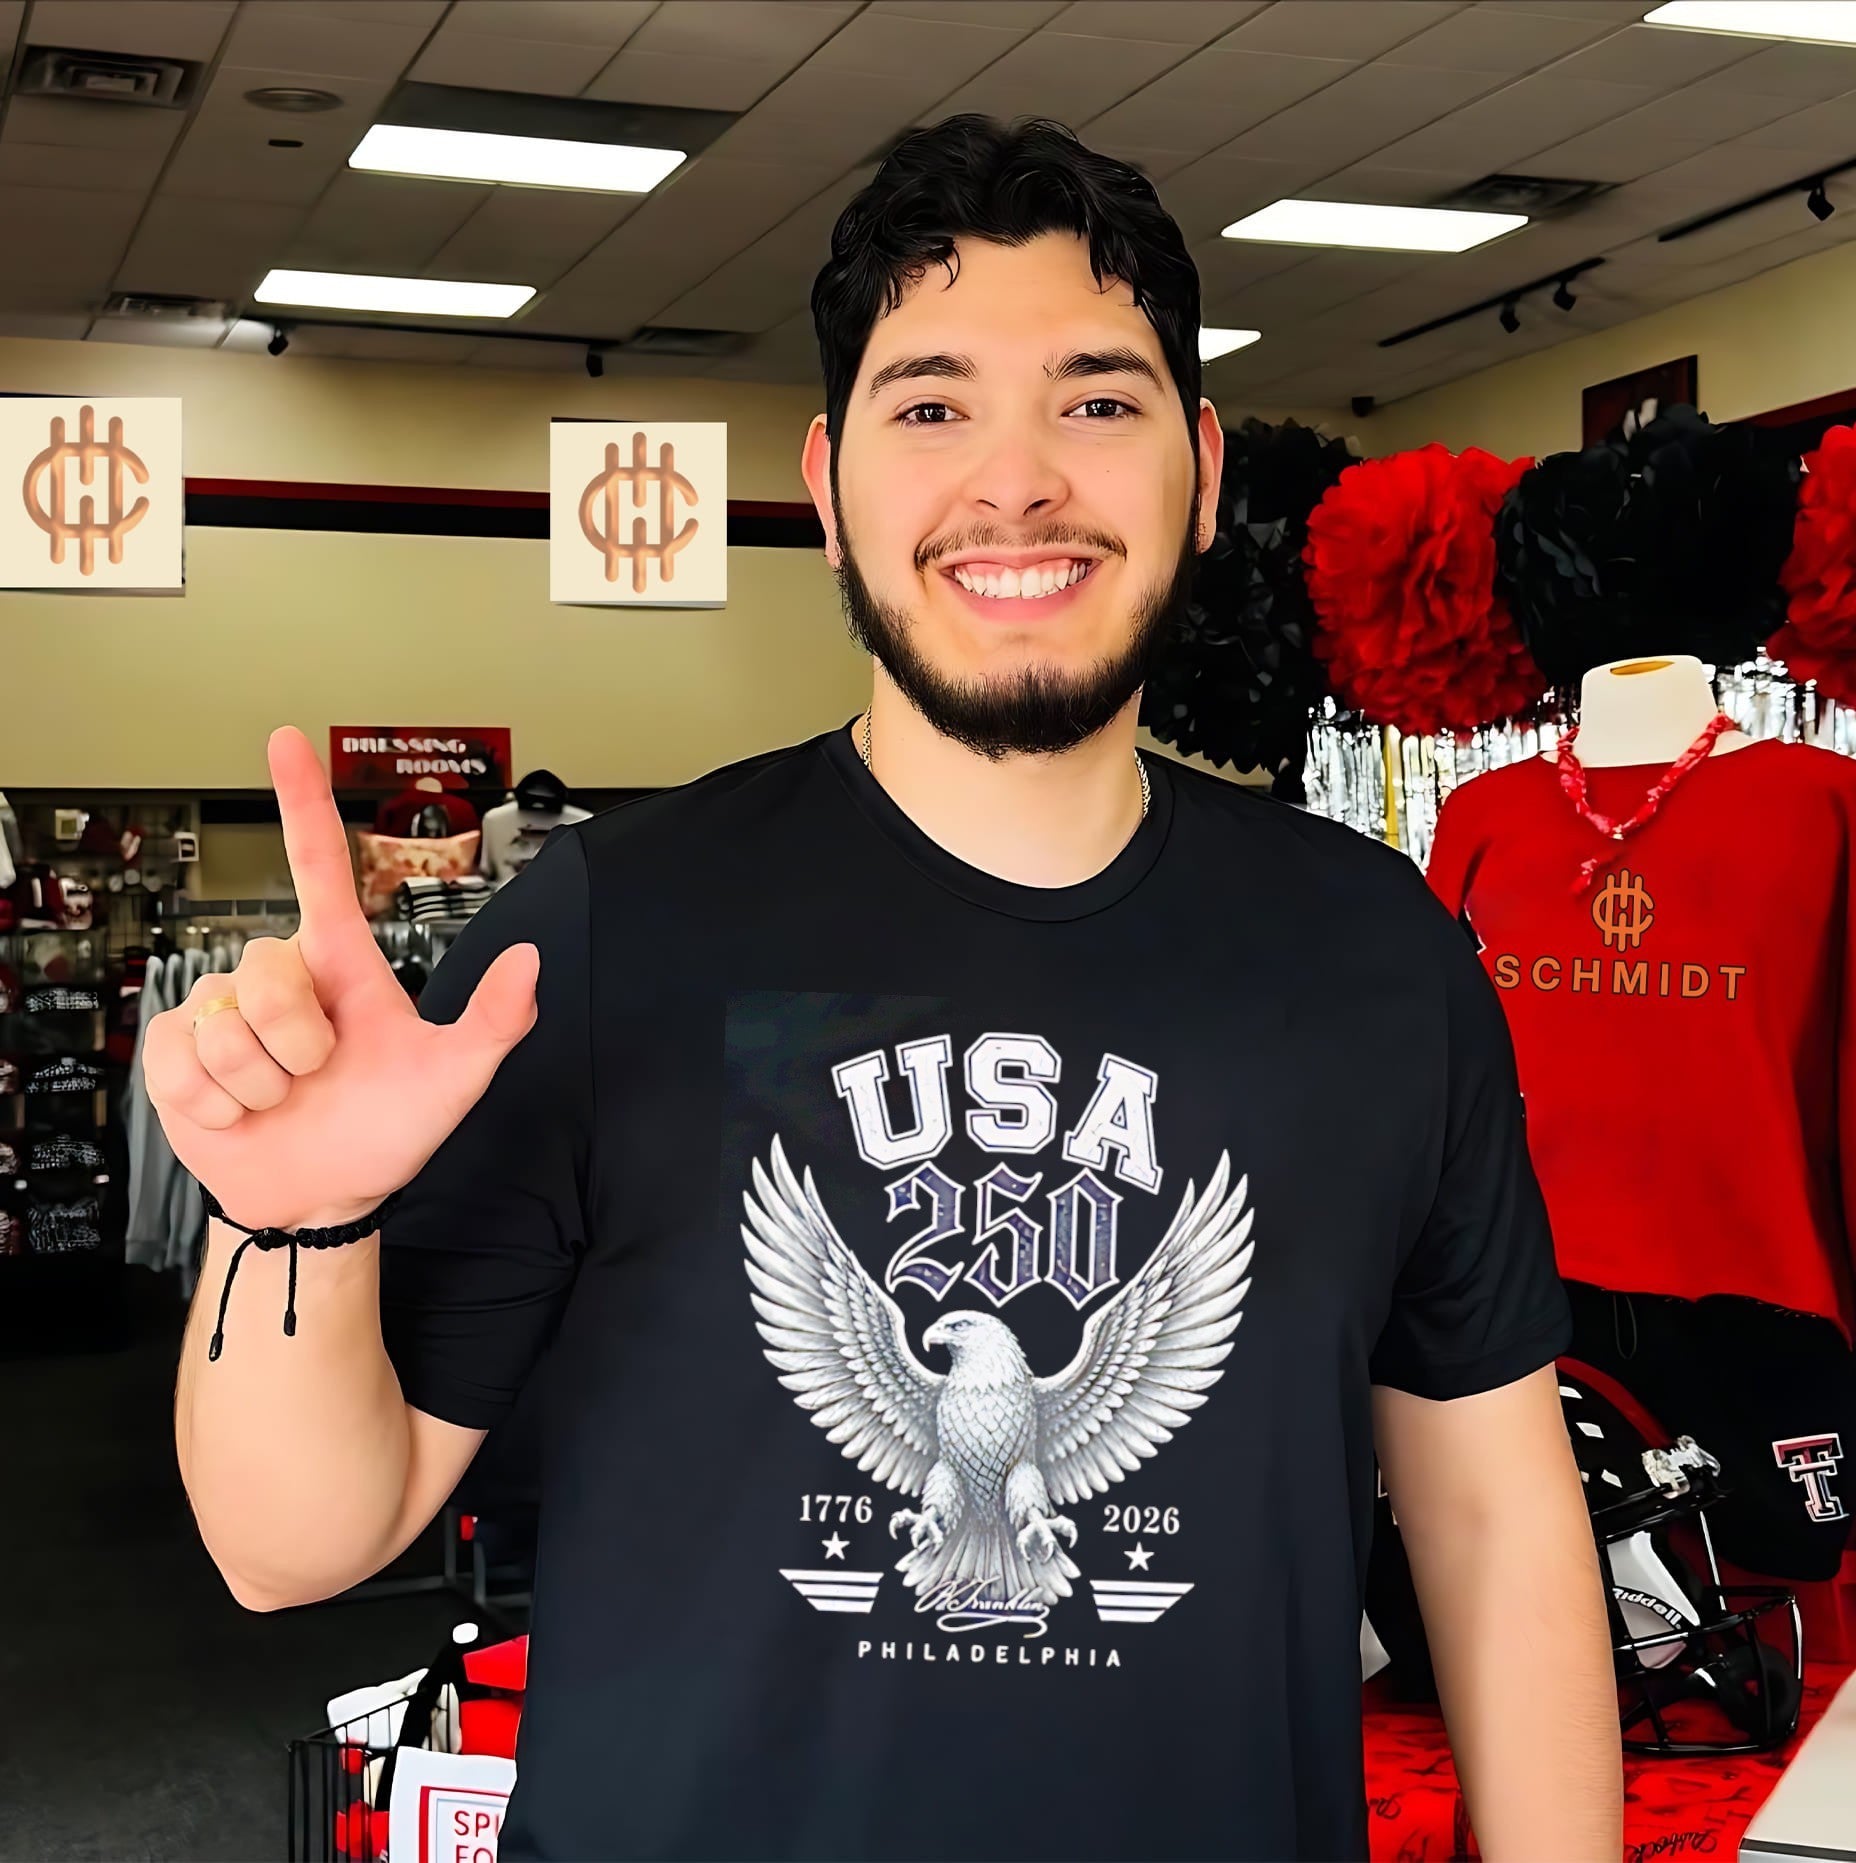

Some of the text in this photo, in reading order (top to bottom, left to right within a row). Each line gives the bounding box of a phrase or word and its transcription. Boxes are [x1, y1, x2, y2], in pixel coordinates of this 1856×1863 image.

[341, 737, 467, 754] DRESSING
[395, 758, 487, 775] ROOMS
[1493, 953, 1747, 1001] SCHMIDT
[831, 1032, 1164, 1195] USA
[884, 1160, 1124, 1311] 250
[798, 1494, 875, 1524] 1776
[1102, 1504, 1181, 1535] 2026
[857, 1639, 1122, 1668] PHILADELPHIA
